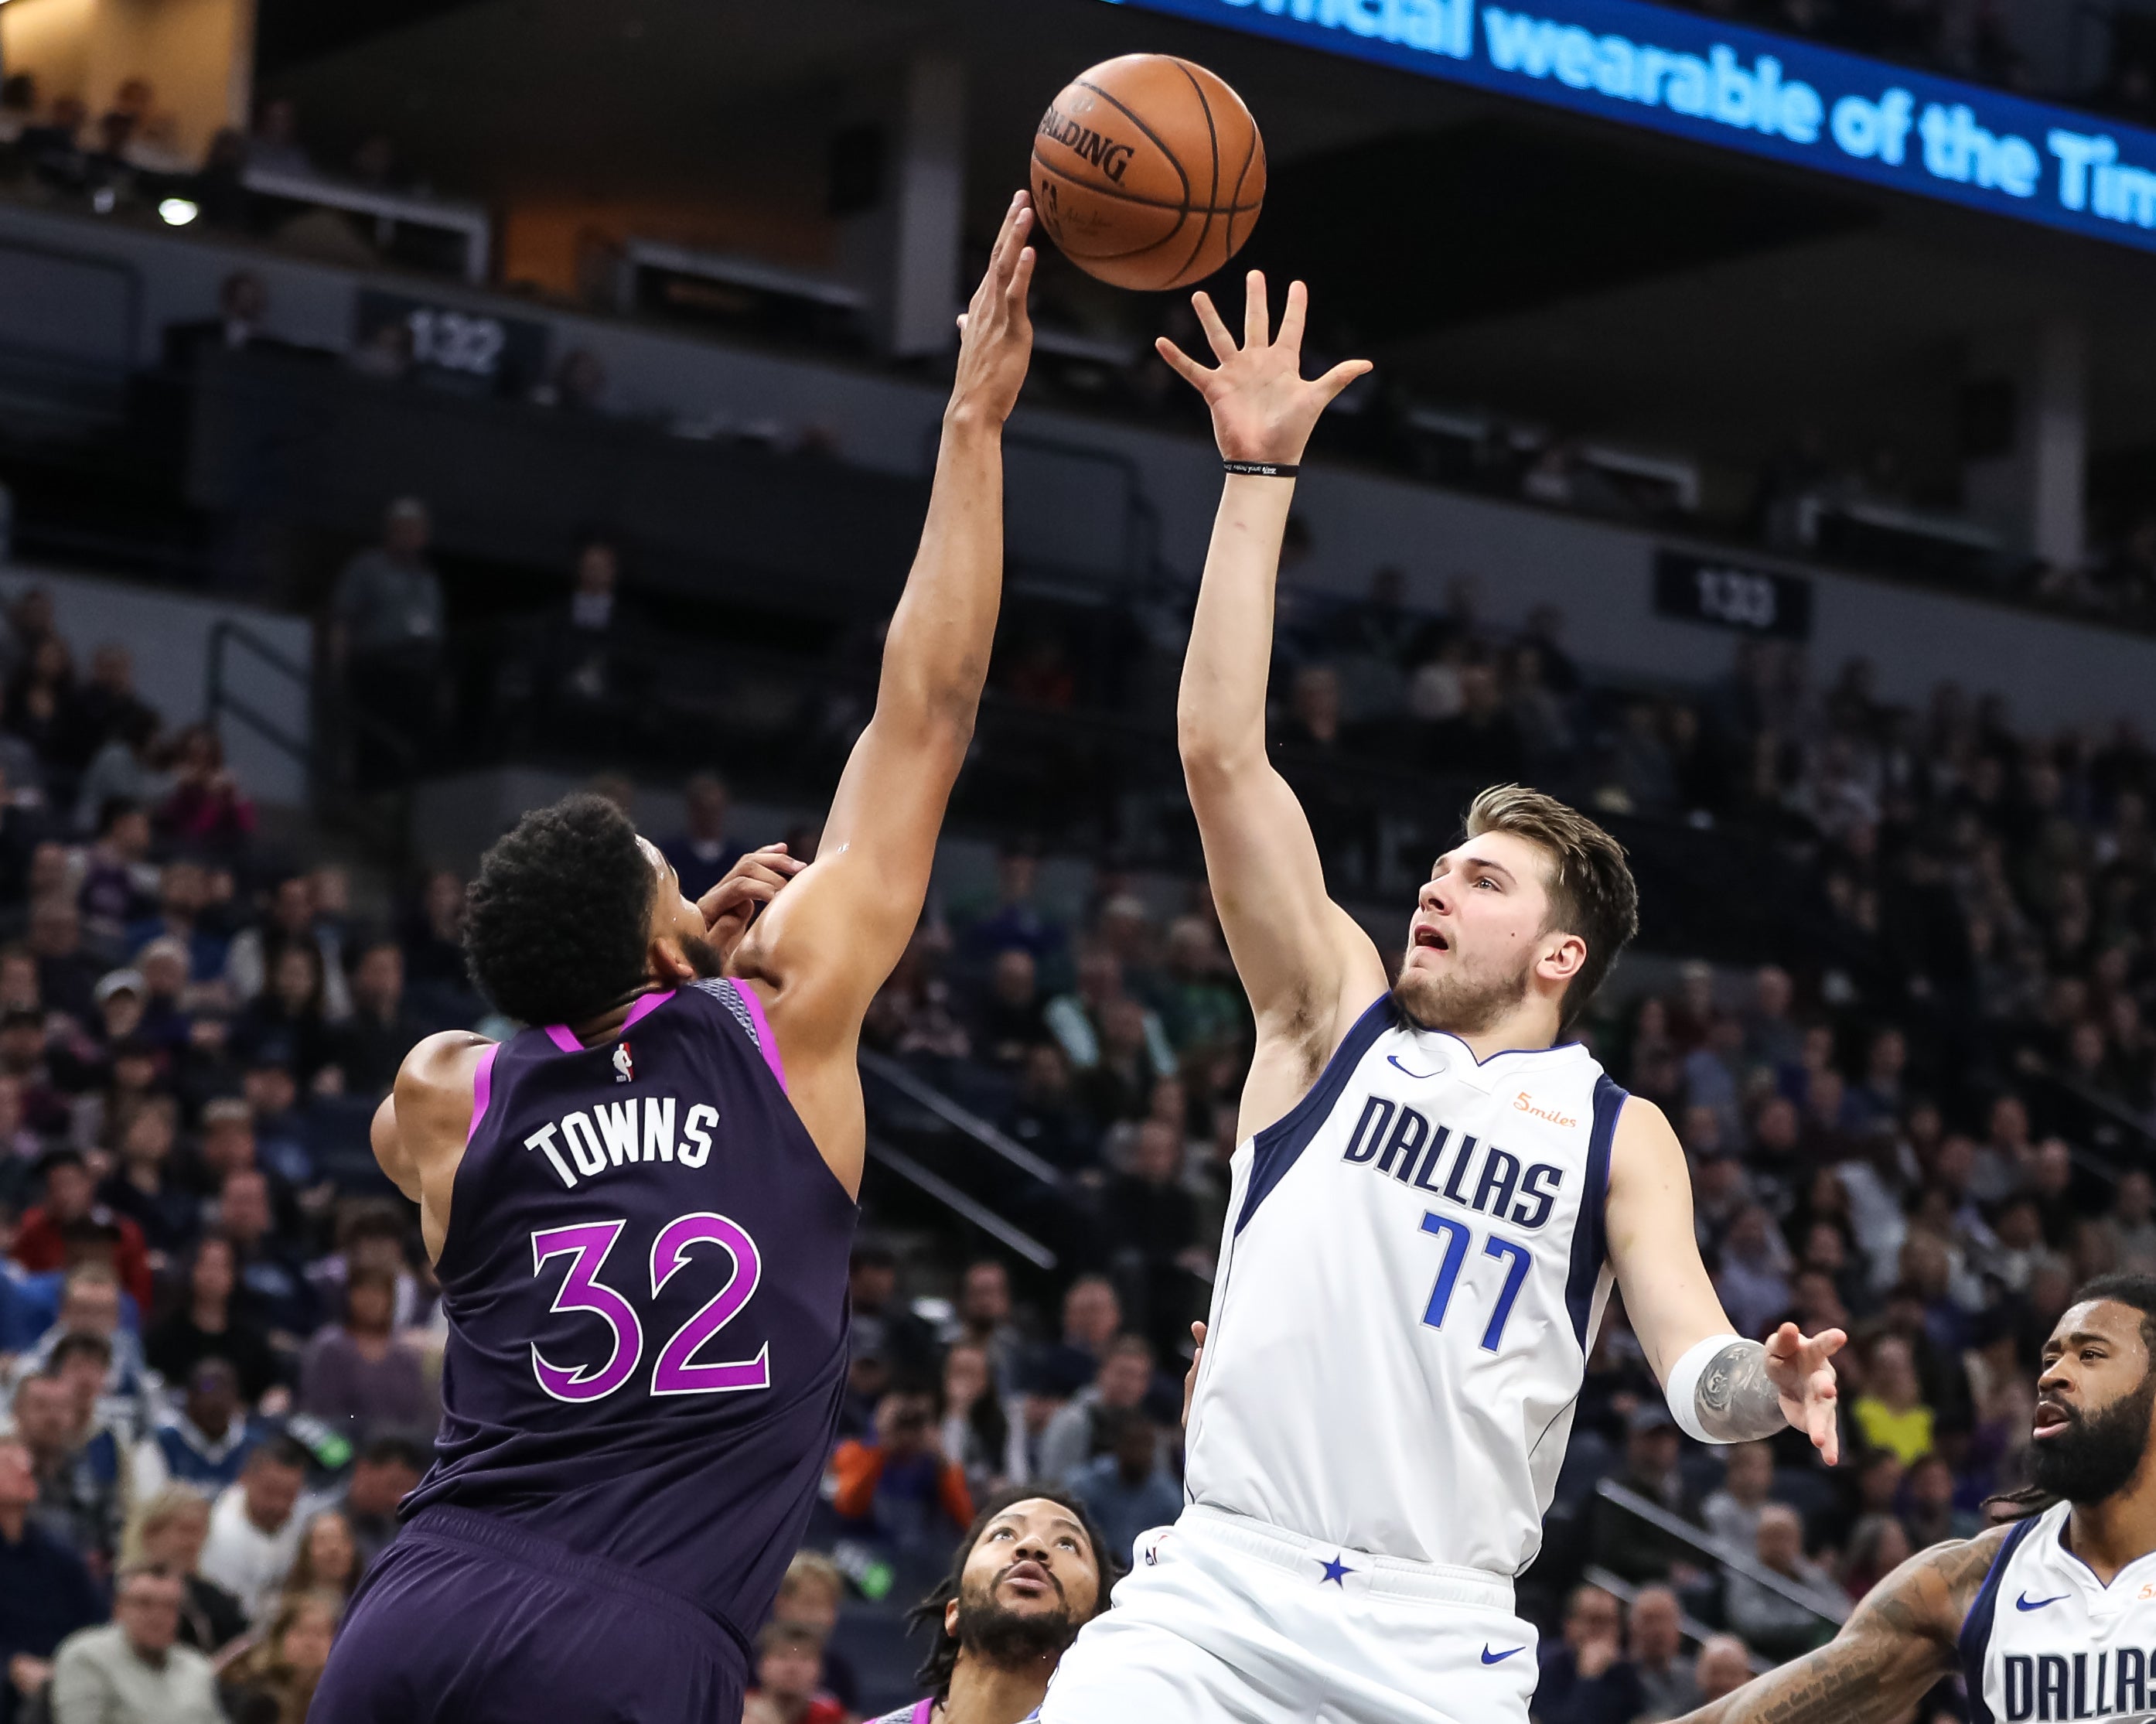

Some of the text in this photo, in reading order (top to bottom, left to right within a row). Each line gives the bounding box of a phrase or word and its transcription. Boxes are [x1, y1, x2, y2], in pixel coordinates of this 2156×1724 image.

[1482, 5, 1823, 144] wearable
[1830, 87, 1915, 166] of
[1919, 101, 2041, 198] the
[524, 1097, 720, 1189] TOWNS
[1340, 1092, 1567, 1232] DALLAS
[1513, 1091, 1577, 1128] 5miles
[530, 1211, 771, 1403] 32
[1417, 1208, 1535, 1356] 77
